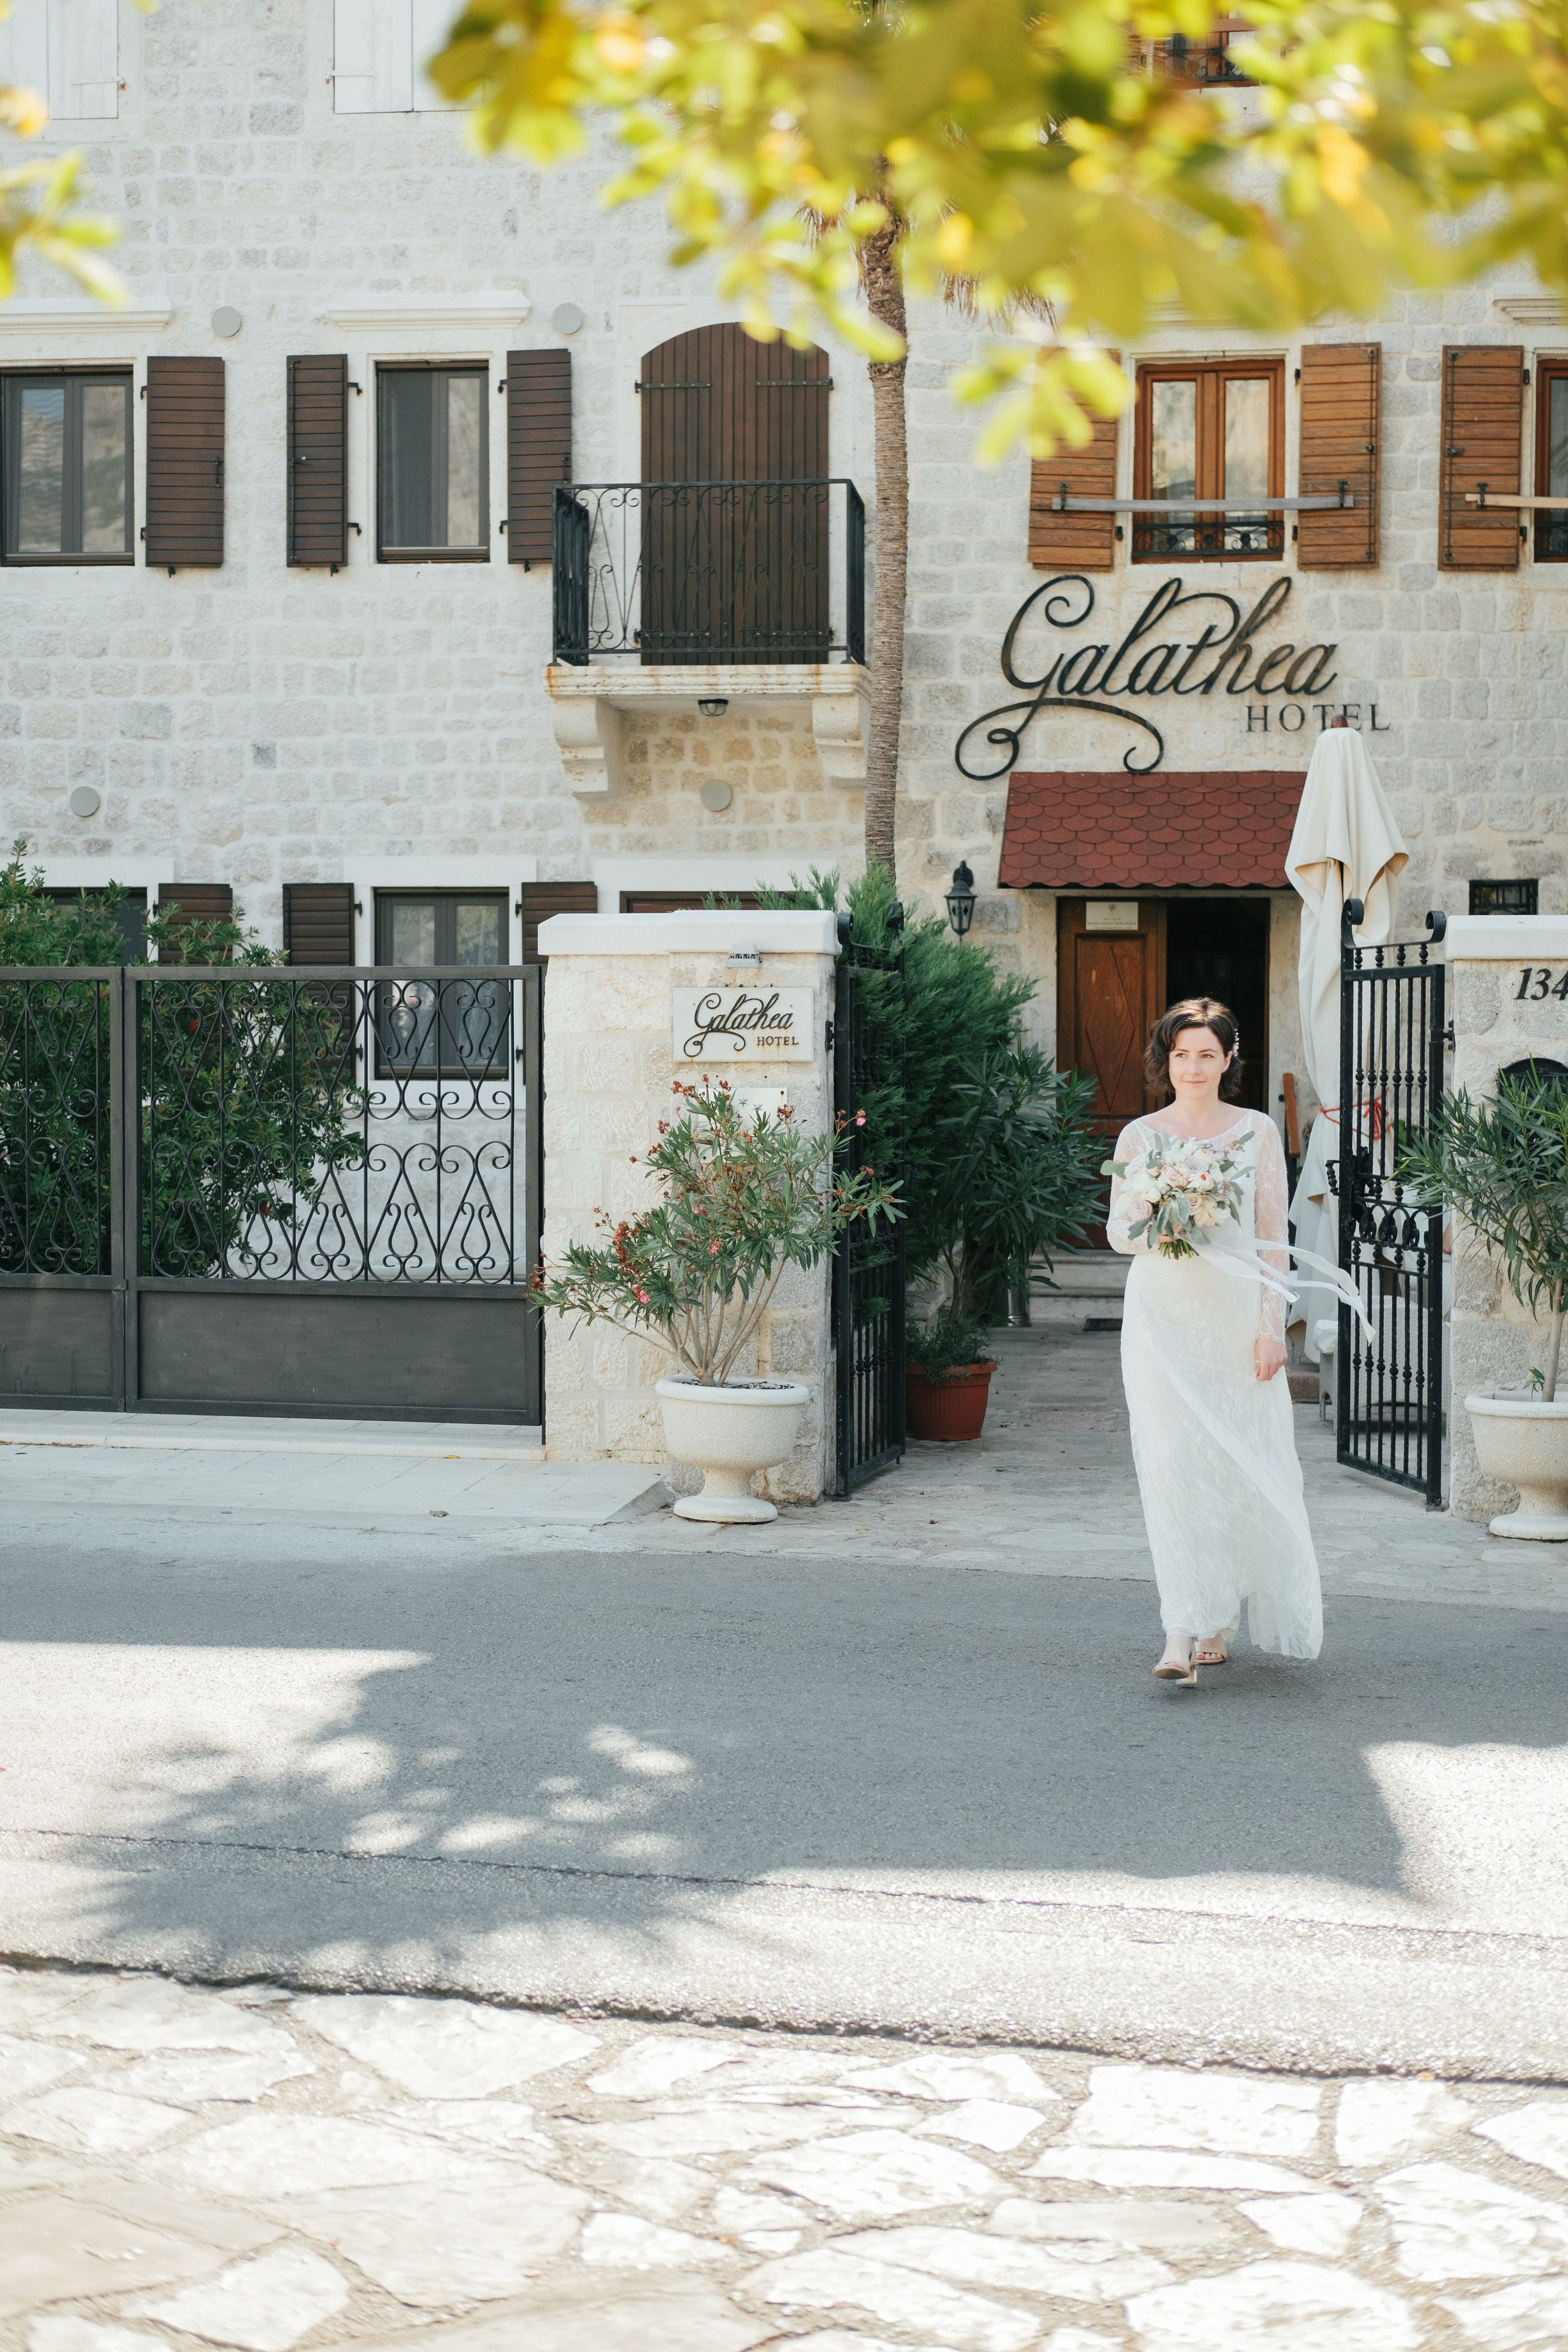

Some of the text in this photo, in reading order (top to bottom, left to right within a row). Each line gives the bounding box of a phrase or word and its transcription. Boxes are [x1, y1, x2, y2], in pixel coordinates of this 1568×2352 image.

[956, 575, 1338, 780] Galathea
[1246, 704, 1390, 732] HOTEL
[1513, 968, 1568, 1000] 134
[684, 993, 794, 1057] Galathea
[756, 1036, 799, 1046] HOTEL
